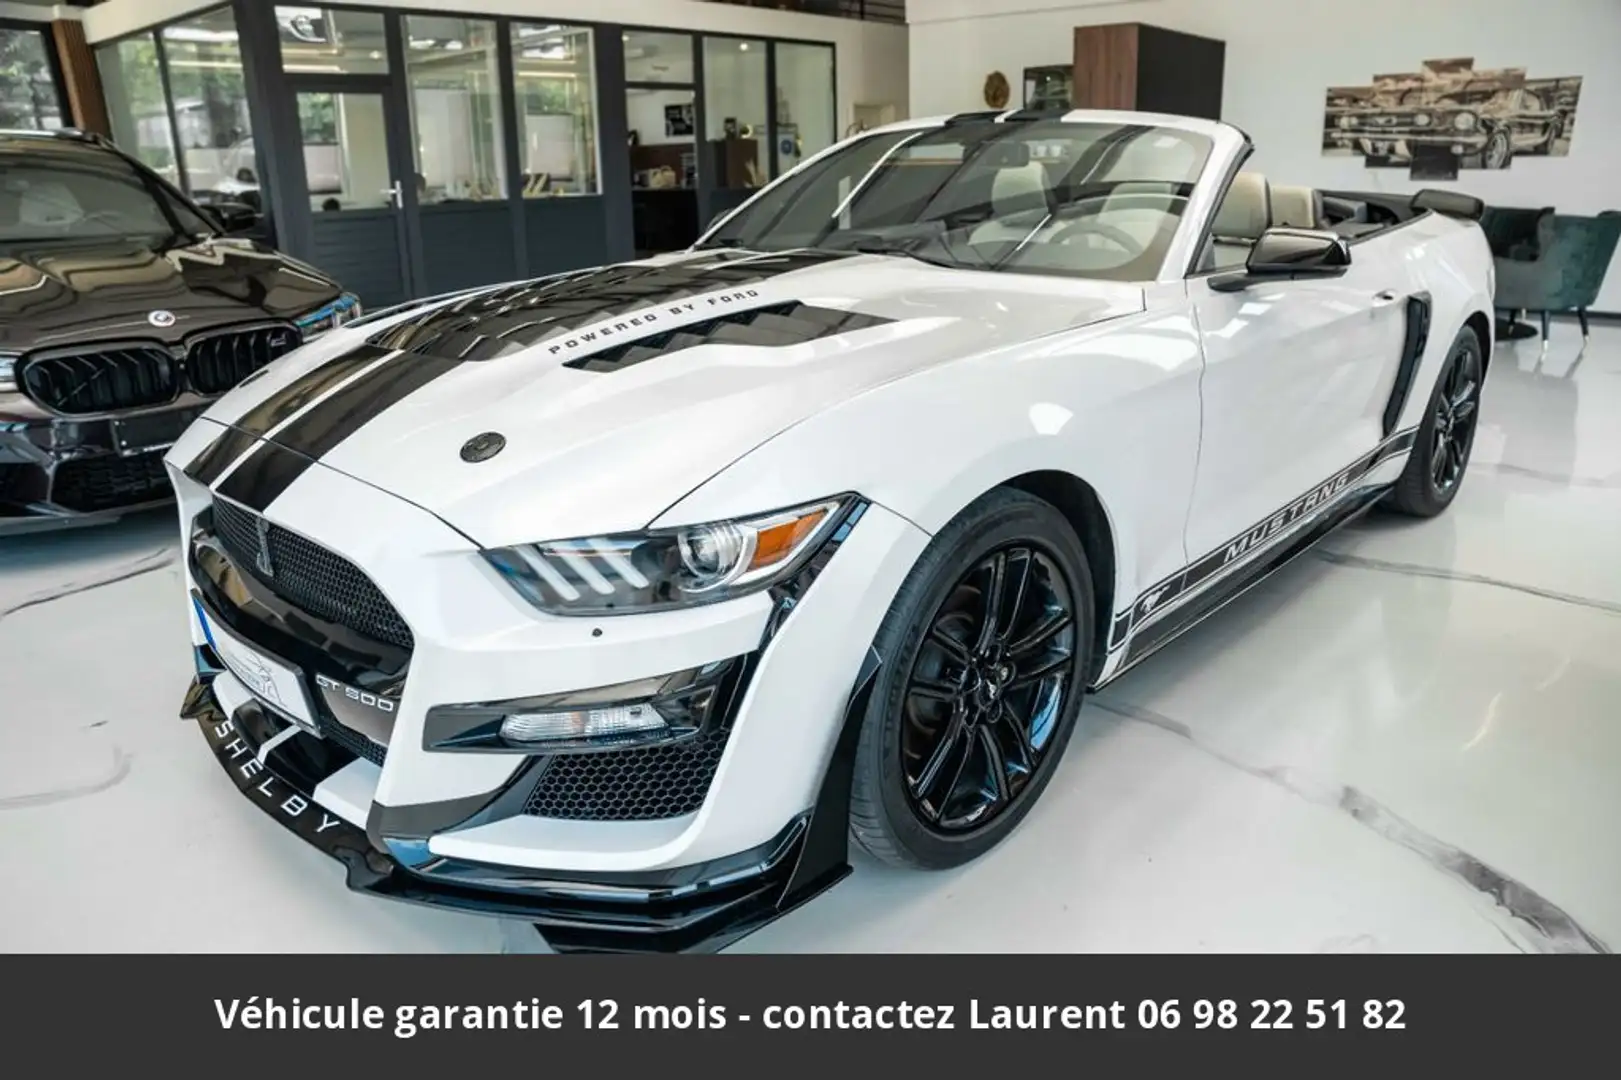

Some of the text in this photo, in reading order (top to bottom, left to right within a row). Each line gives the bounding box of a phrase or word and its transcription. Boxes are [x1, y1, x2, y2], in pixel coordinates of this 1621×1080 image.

[548, 289, 760, 355] POWERED BY FORD
[1223, 473, 1351, 563] MUSTANG
[315, 673, 394, 712] GT 500
[214, 719, 341, 833] SHELBY
